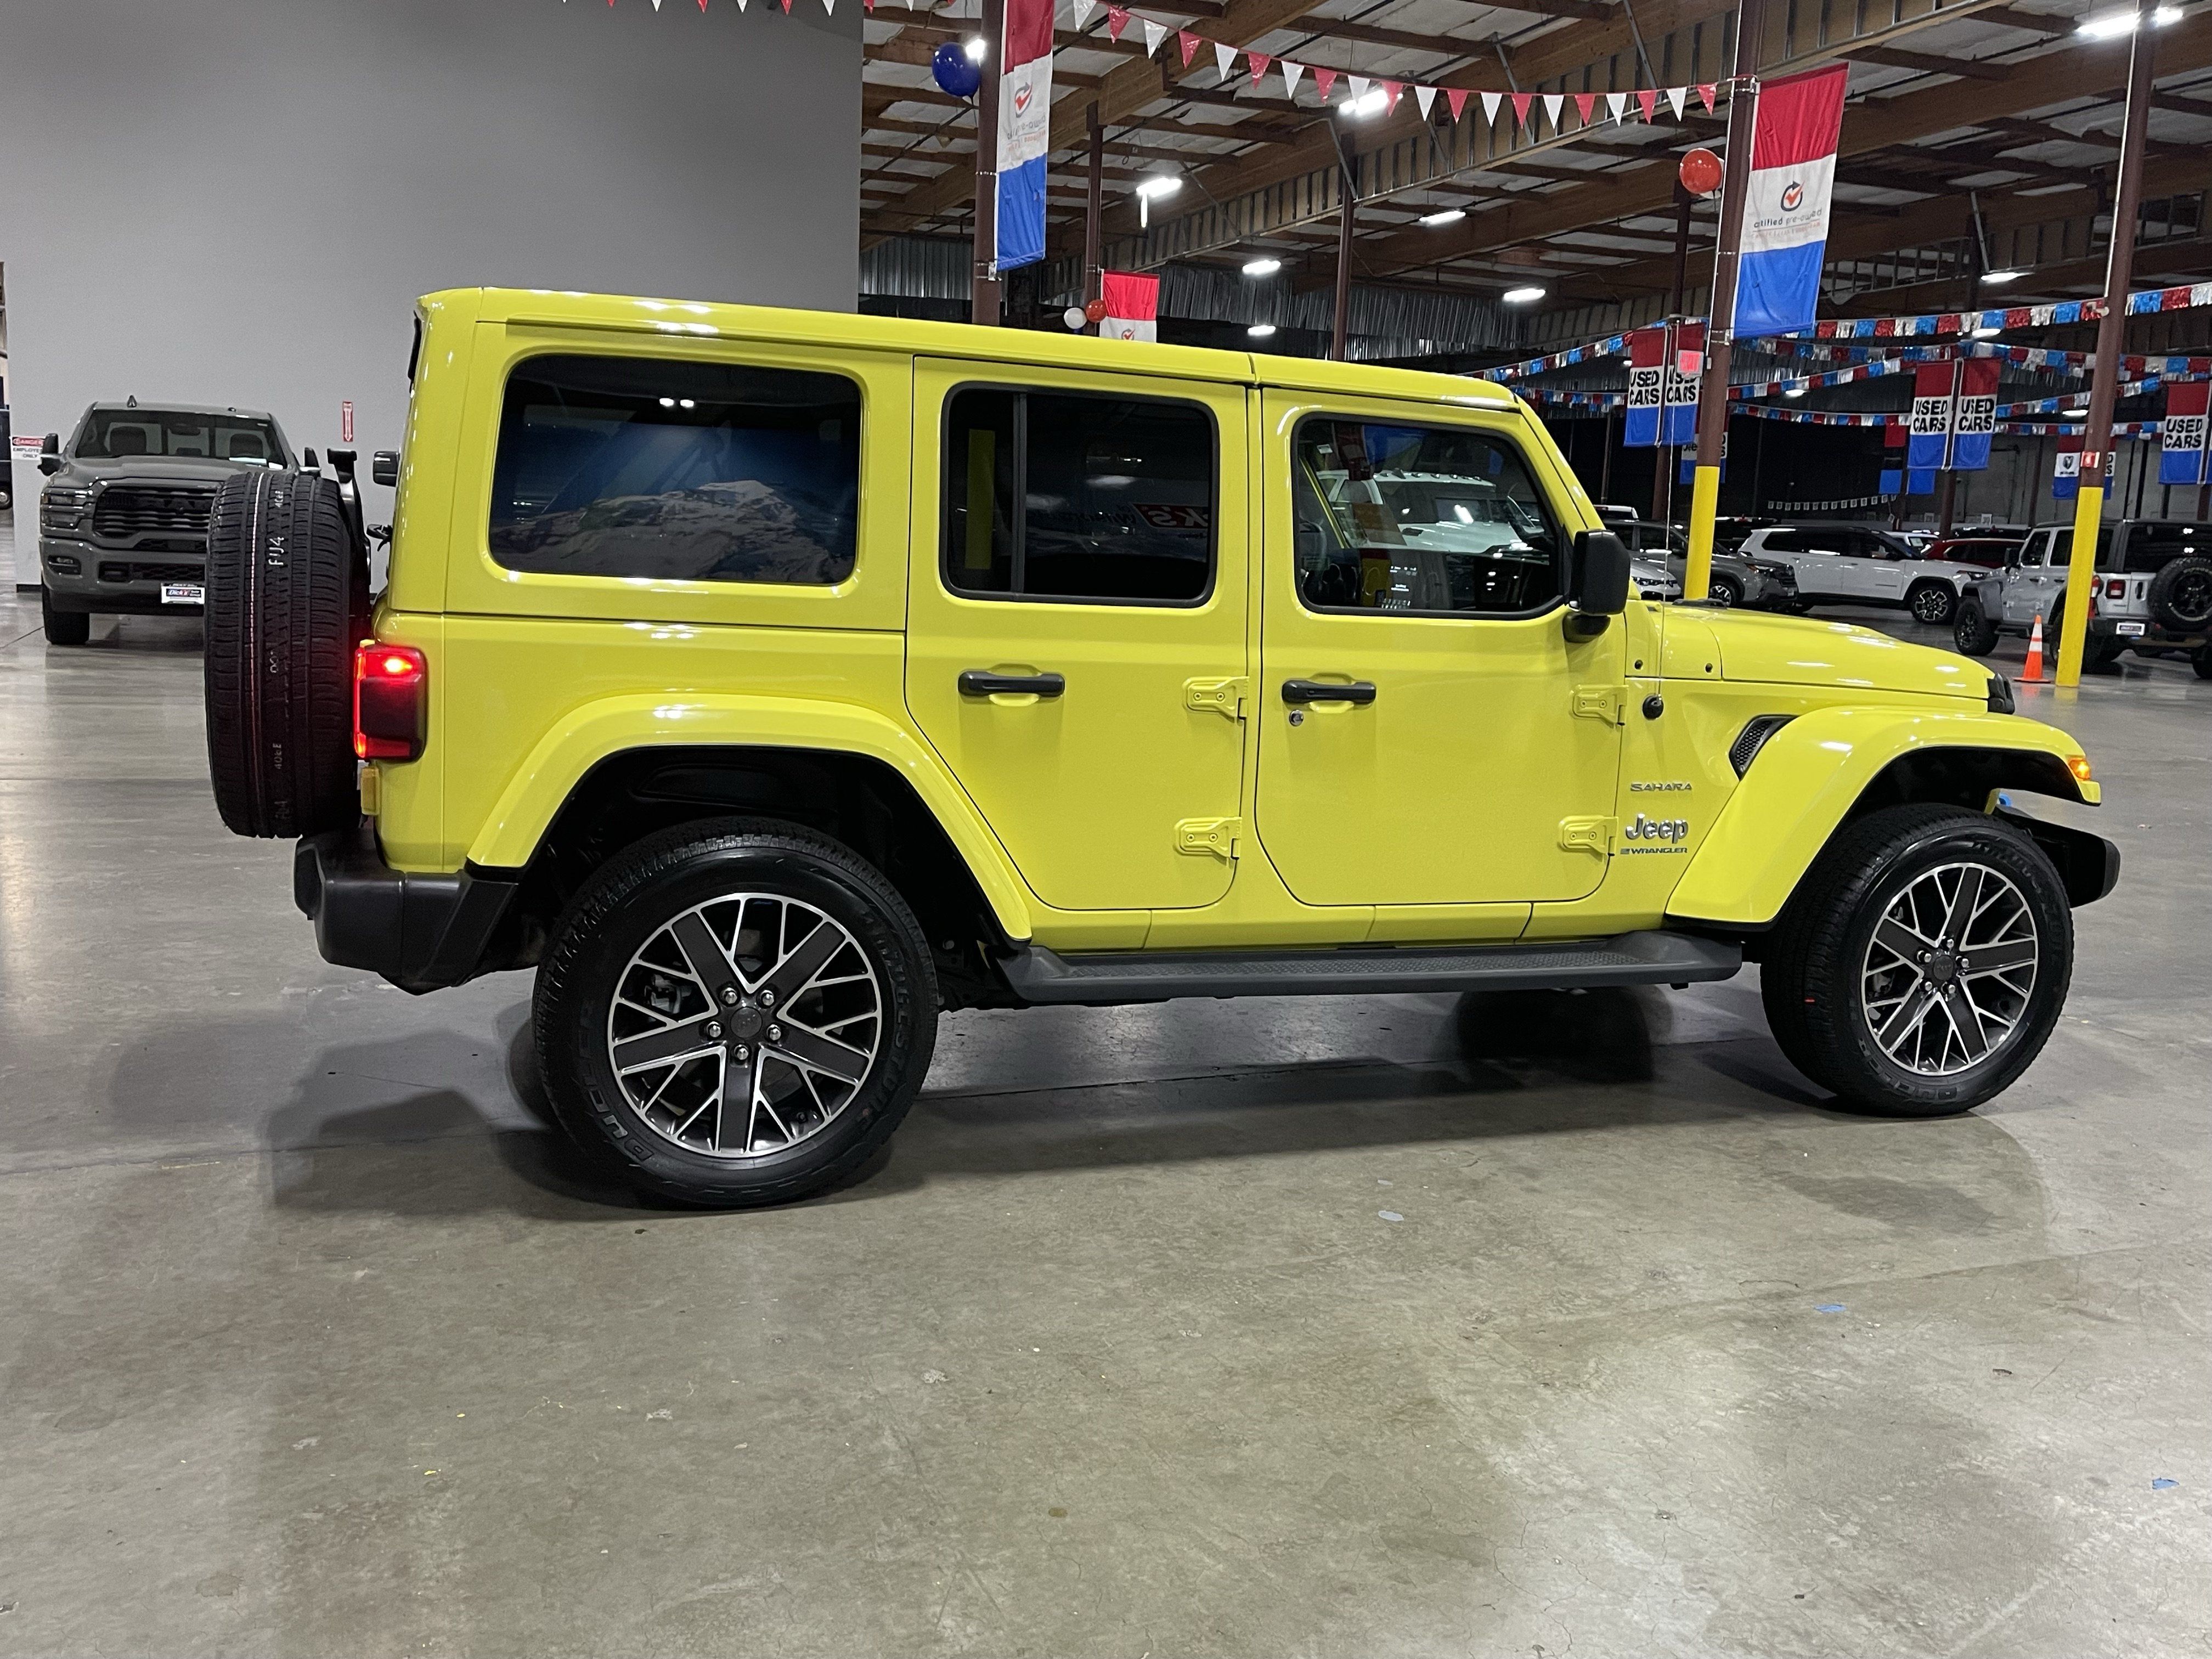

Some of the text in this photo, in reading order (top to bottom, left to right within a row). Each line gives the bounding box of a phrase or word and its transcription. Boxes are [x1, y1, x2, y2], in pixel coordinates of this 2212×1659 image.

[1630, 370, 1660, 388] USED
[1629, 388, 1660, 405] CARS
[1666, 385, 1696, 403] CARS
[1915, 400, 1948, 415] USED
[1913, 417, 1946, 432] CARS
[1959, 415, 1993, 431] CARS
[2166, 419, 2203, 433] USED
[2164, 435, 2202, 449] CARS
[1630, 782, 1692, 792] SAHARA
[1626, 813, 1689, 844] Jeep
